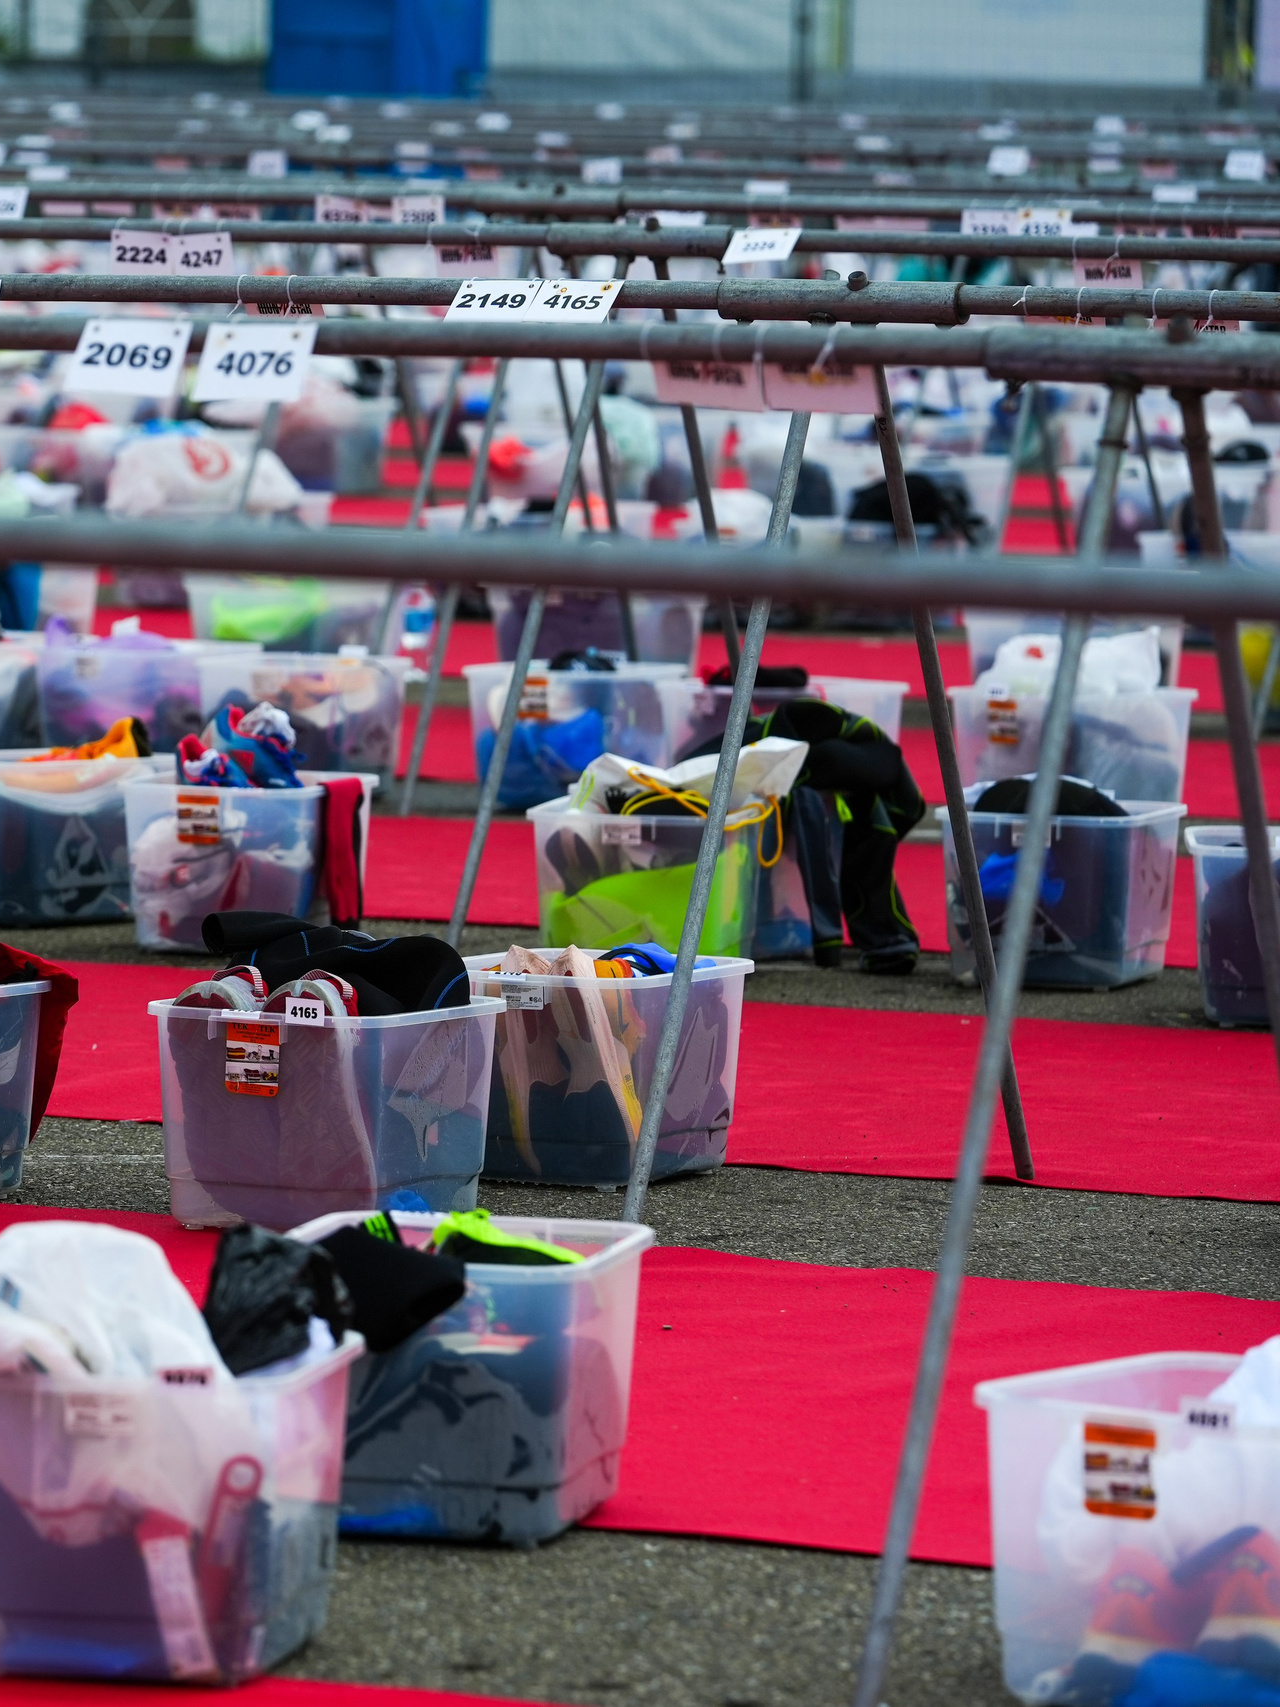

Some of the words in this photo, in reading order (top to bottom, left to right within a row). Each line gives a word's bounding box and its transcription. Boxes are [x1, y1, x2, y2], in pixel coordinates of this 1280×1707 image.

[114, 245, 169, 264] 2224
[180, 249, 224, 268] 4247
[455, 293, 527, 309] 2149
[542, 294, 604, 311] 4165
[81, 342, 173, 371] 2069
[215, 350, 293, 377] 4076
[290, 1005, 318, 1019] 4165
